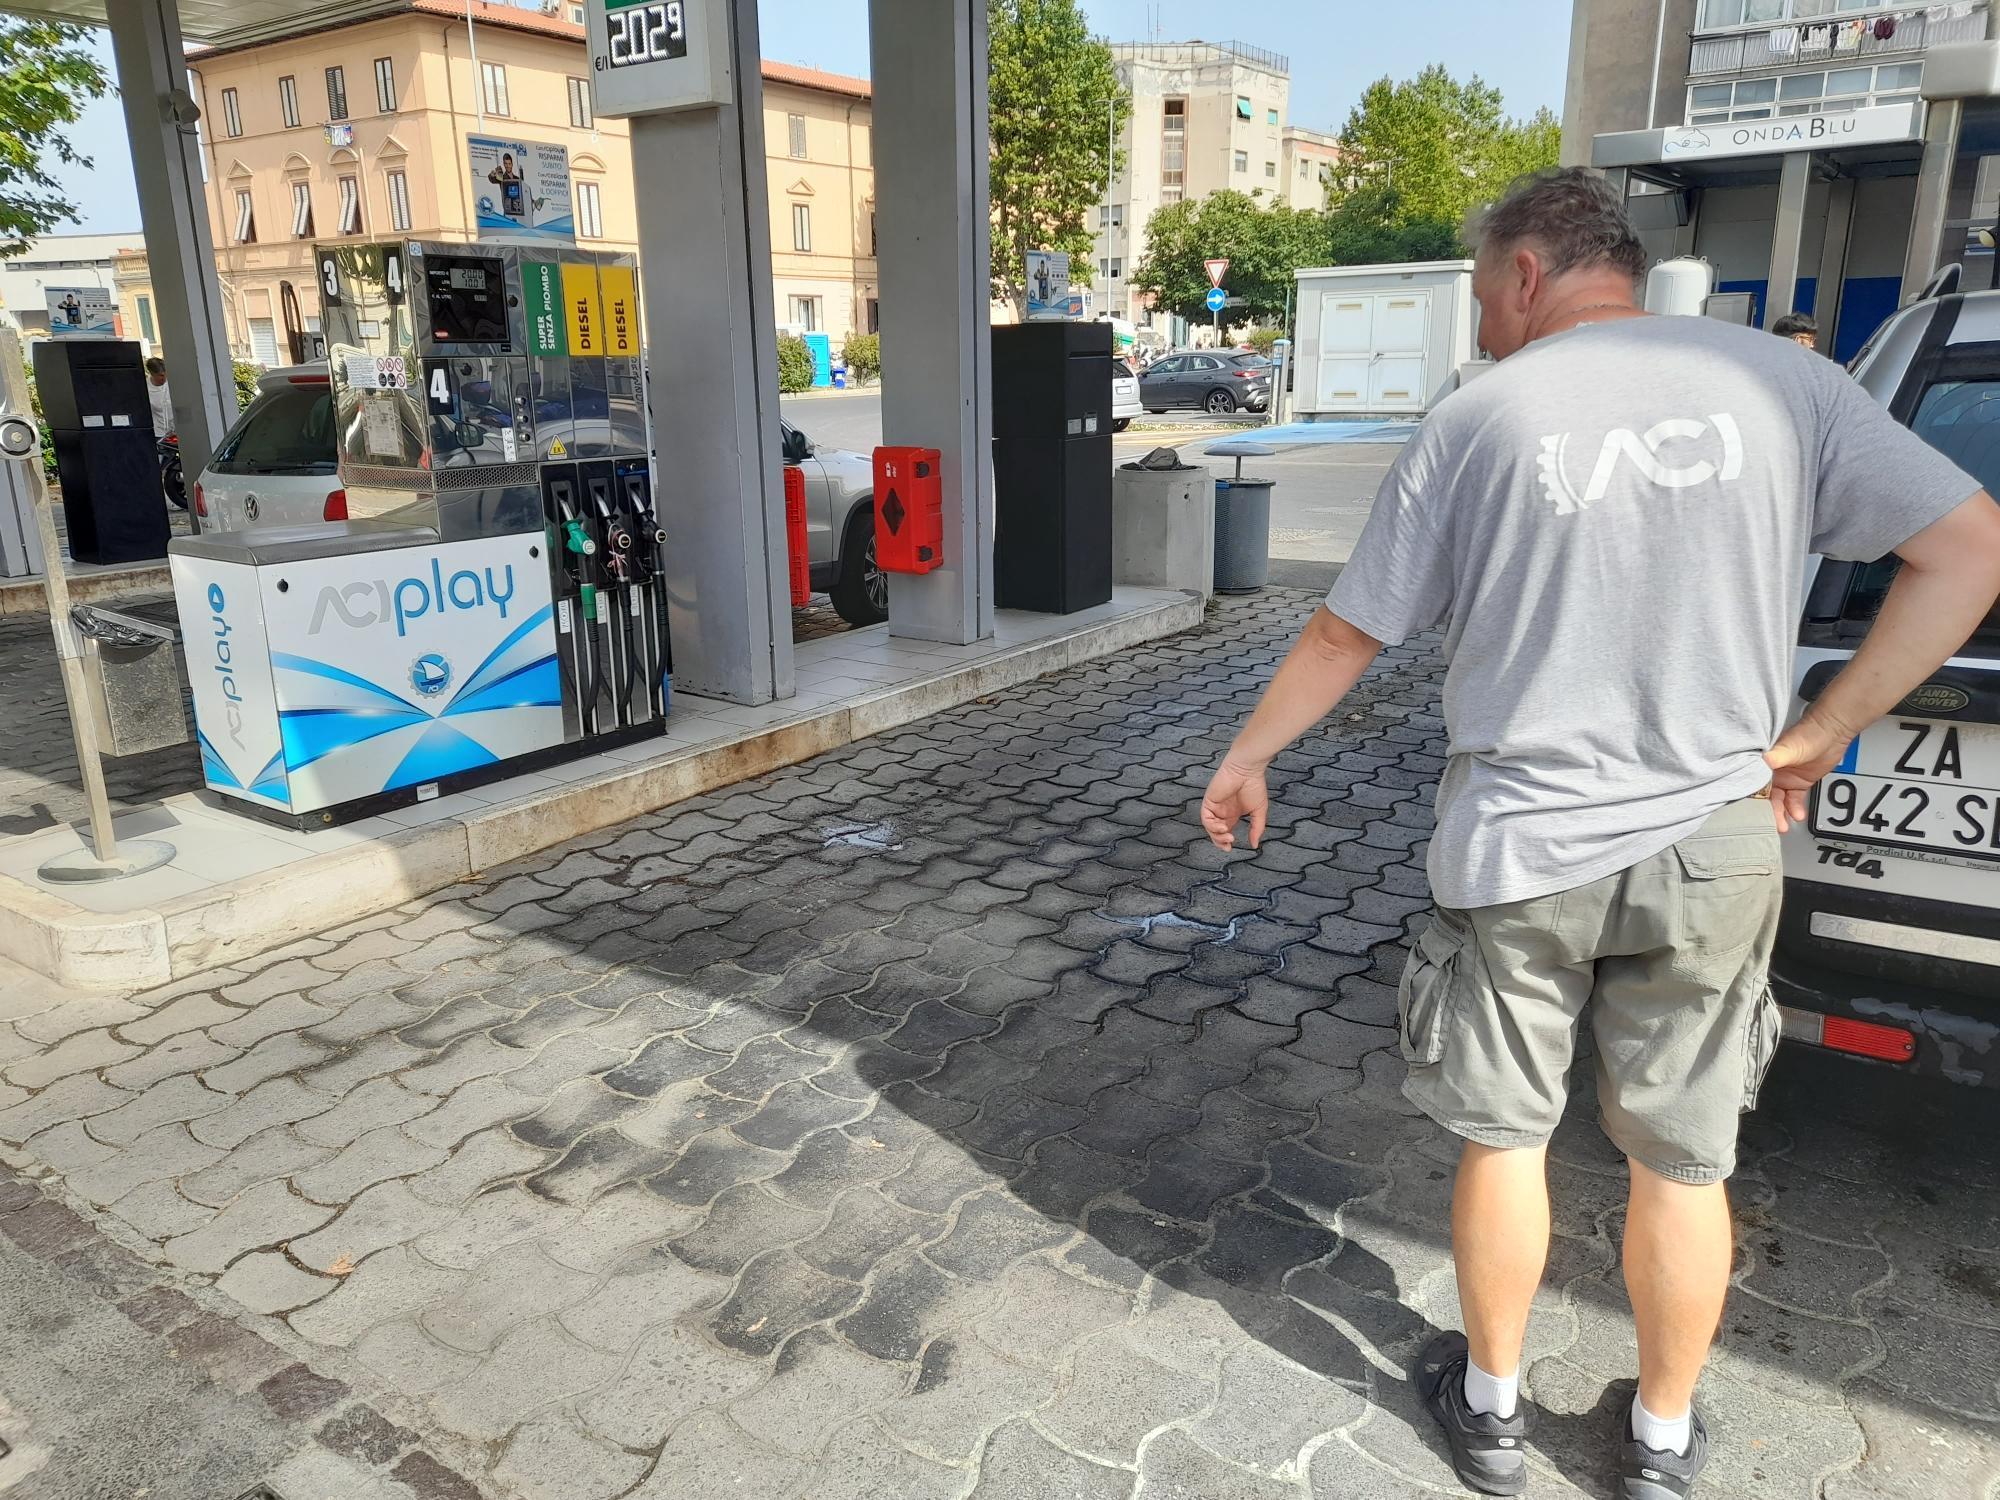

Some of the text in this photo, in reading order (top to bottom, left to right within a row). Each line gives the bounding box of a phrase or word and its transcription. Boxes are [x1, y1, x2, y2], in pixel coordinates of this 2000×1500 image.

[323, 260, 338, 296] 3
[387, 256, 400, 293] 4
[540, 265, 555, 350] SENZA PIOMBO
[577, 297, 591, 350] DIESEL
[614, 299, 627, 350] DIESEL
[315, 341, 325, 358] 8
[537, 315, 548, 350] SUPER
[430, 368, 449, 403] 4
[1894, 722, 1962, 779] ZA
[1827, 779, 1930, 838] 942
[1866, 845, 1903, 857] Pardini
